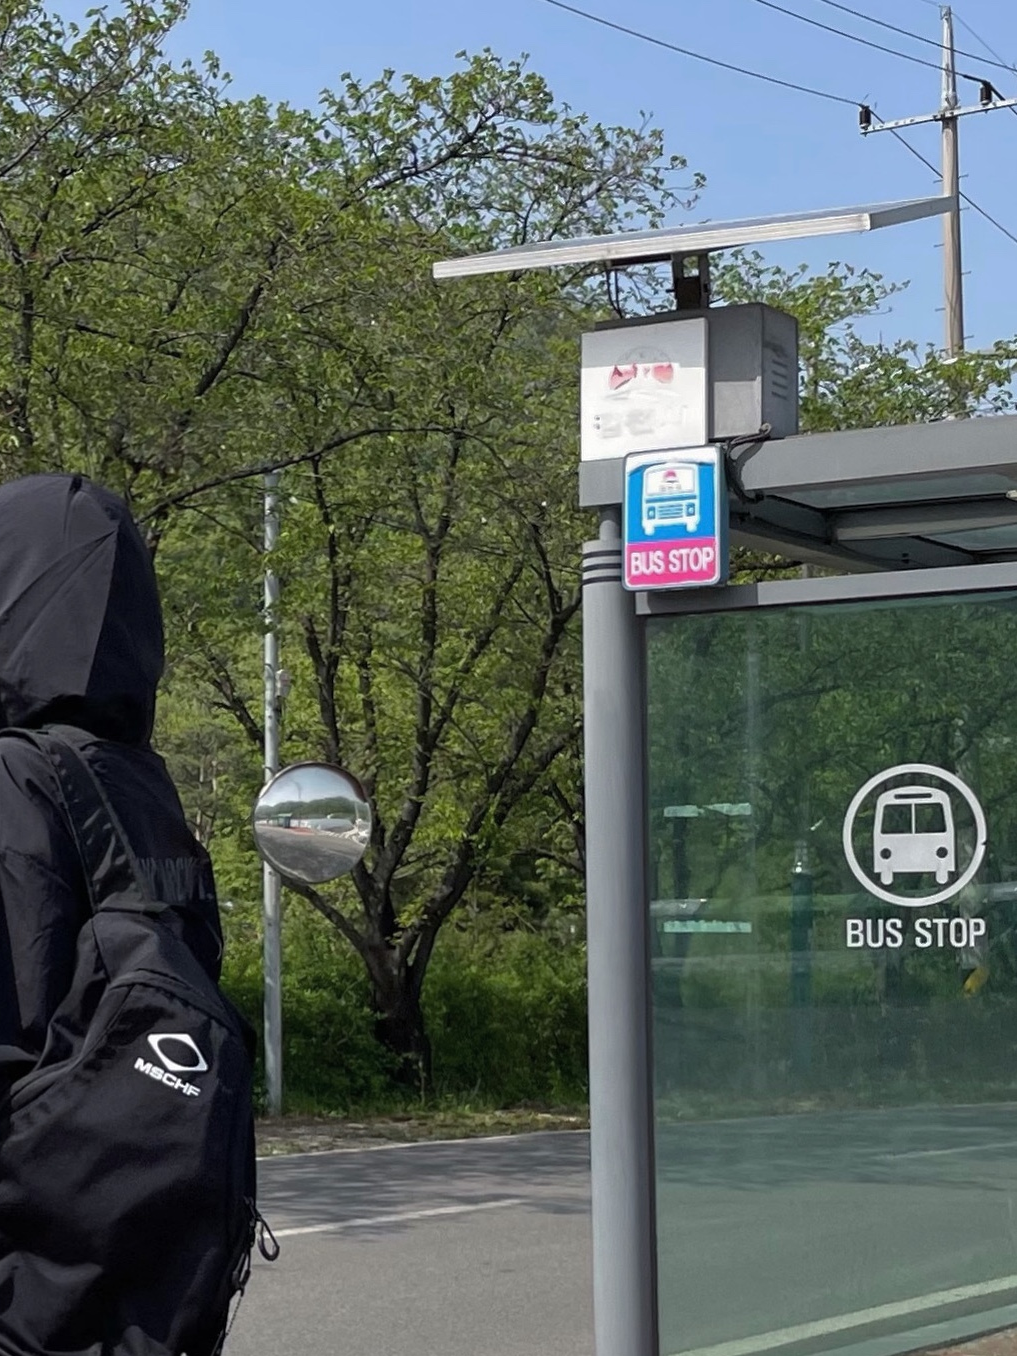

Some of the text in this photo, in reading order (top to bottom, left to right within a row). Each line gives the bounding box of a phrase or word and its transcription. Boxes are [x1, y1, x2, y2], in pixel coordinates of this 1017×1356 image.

[631, 547, 714, 575] BUS STOP
[846, 918, 986, 948] BUS STOP
[134, 1057, 201, 1096] MSCHF
